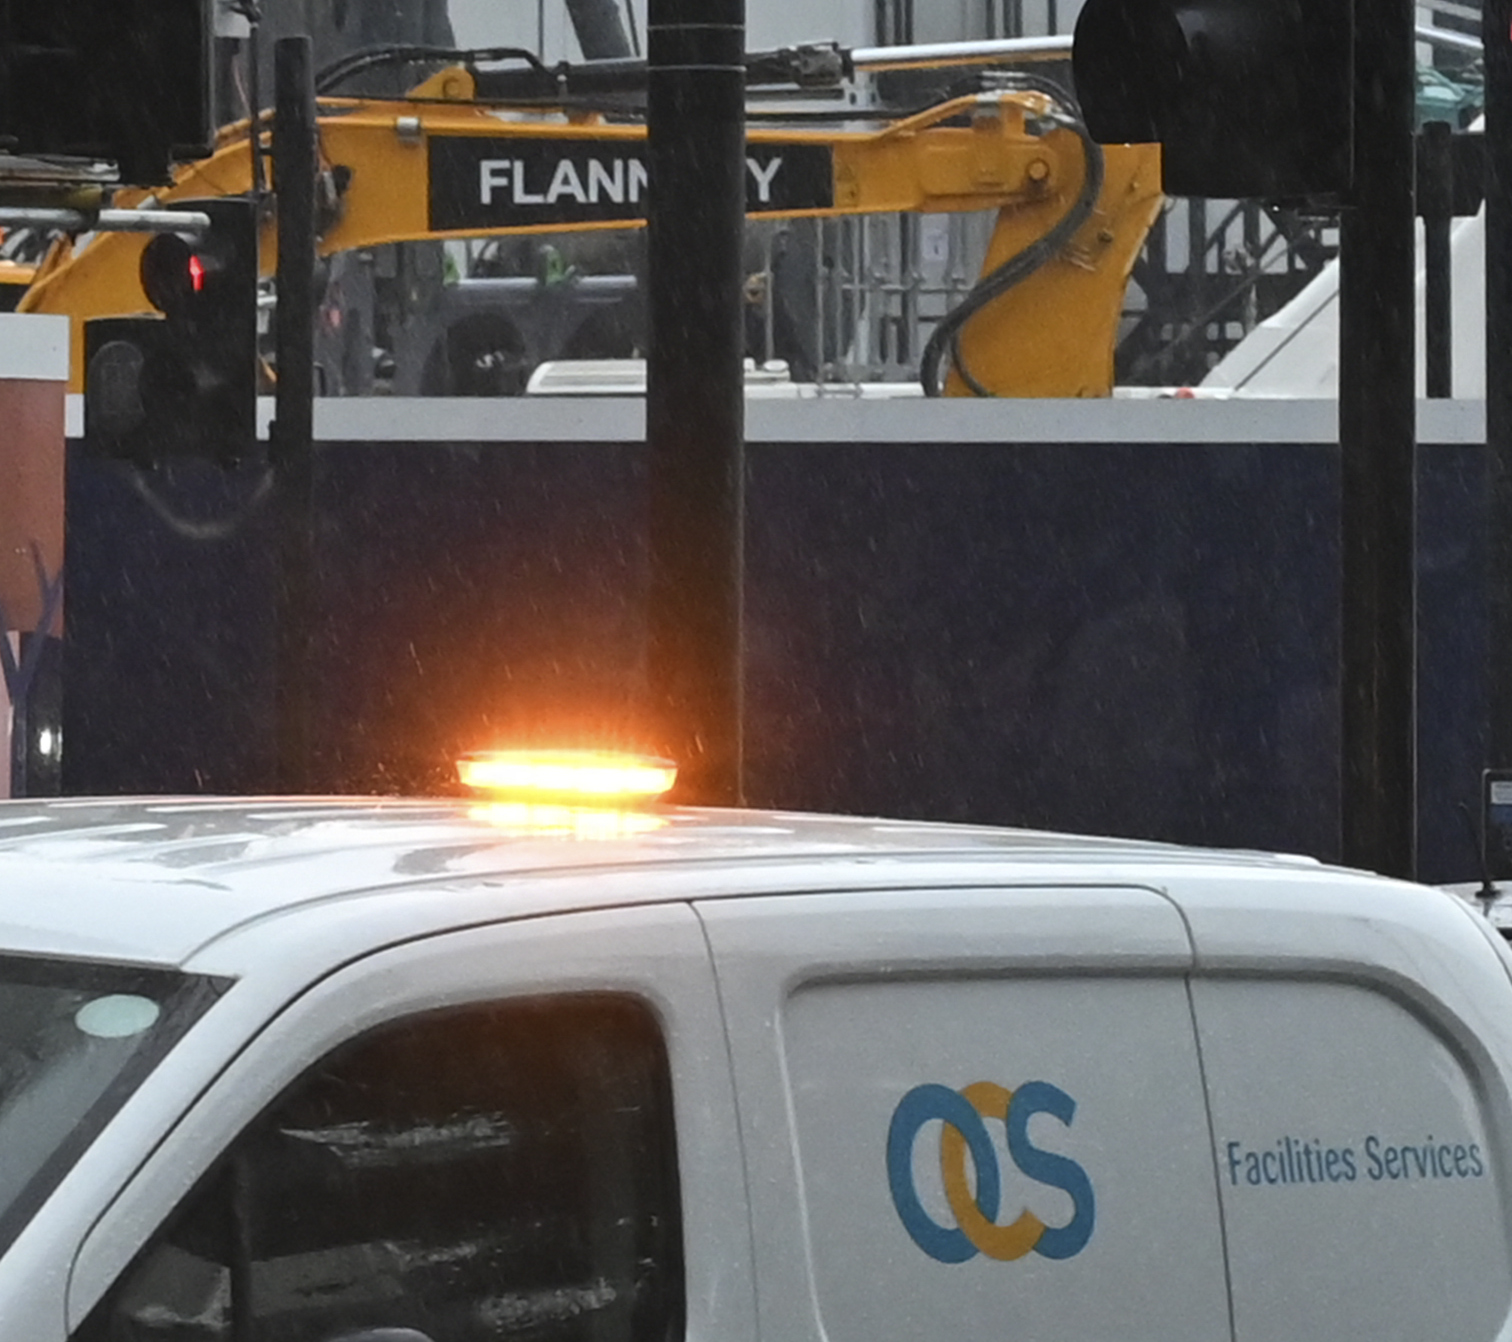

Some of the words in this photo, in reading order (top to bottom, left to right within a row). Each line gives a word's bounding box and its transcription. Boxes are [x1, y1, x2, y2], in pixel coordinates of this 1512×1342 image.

[480, 158, 782, 204] FLANNY
[887, 1080, 1096, 1264] OCS
[1226, 1137, 1358, 1186] Facilities
[1364, 1134, 1484, 1181] Services
